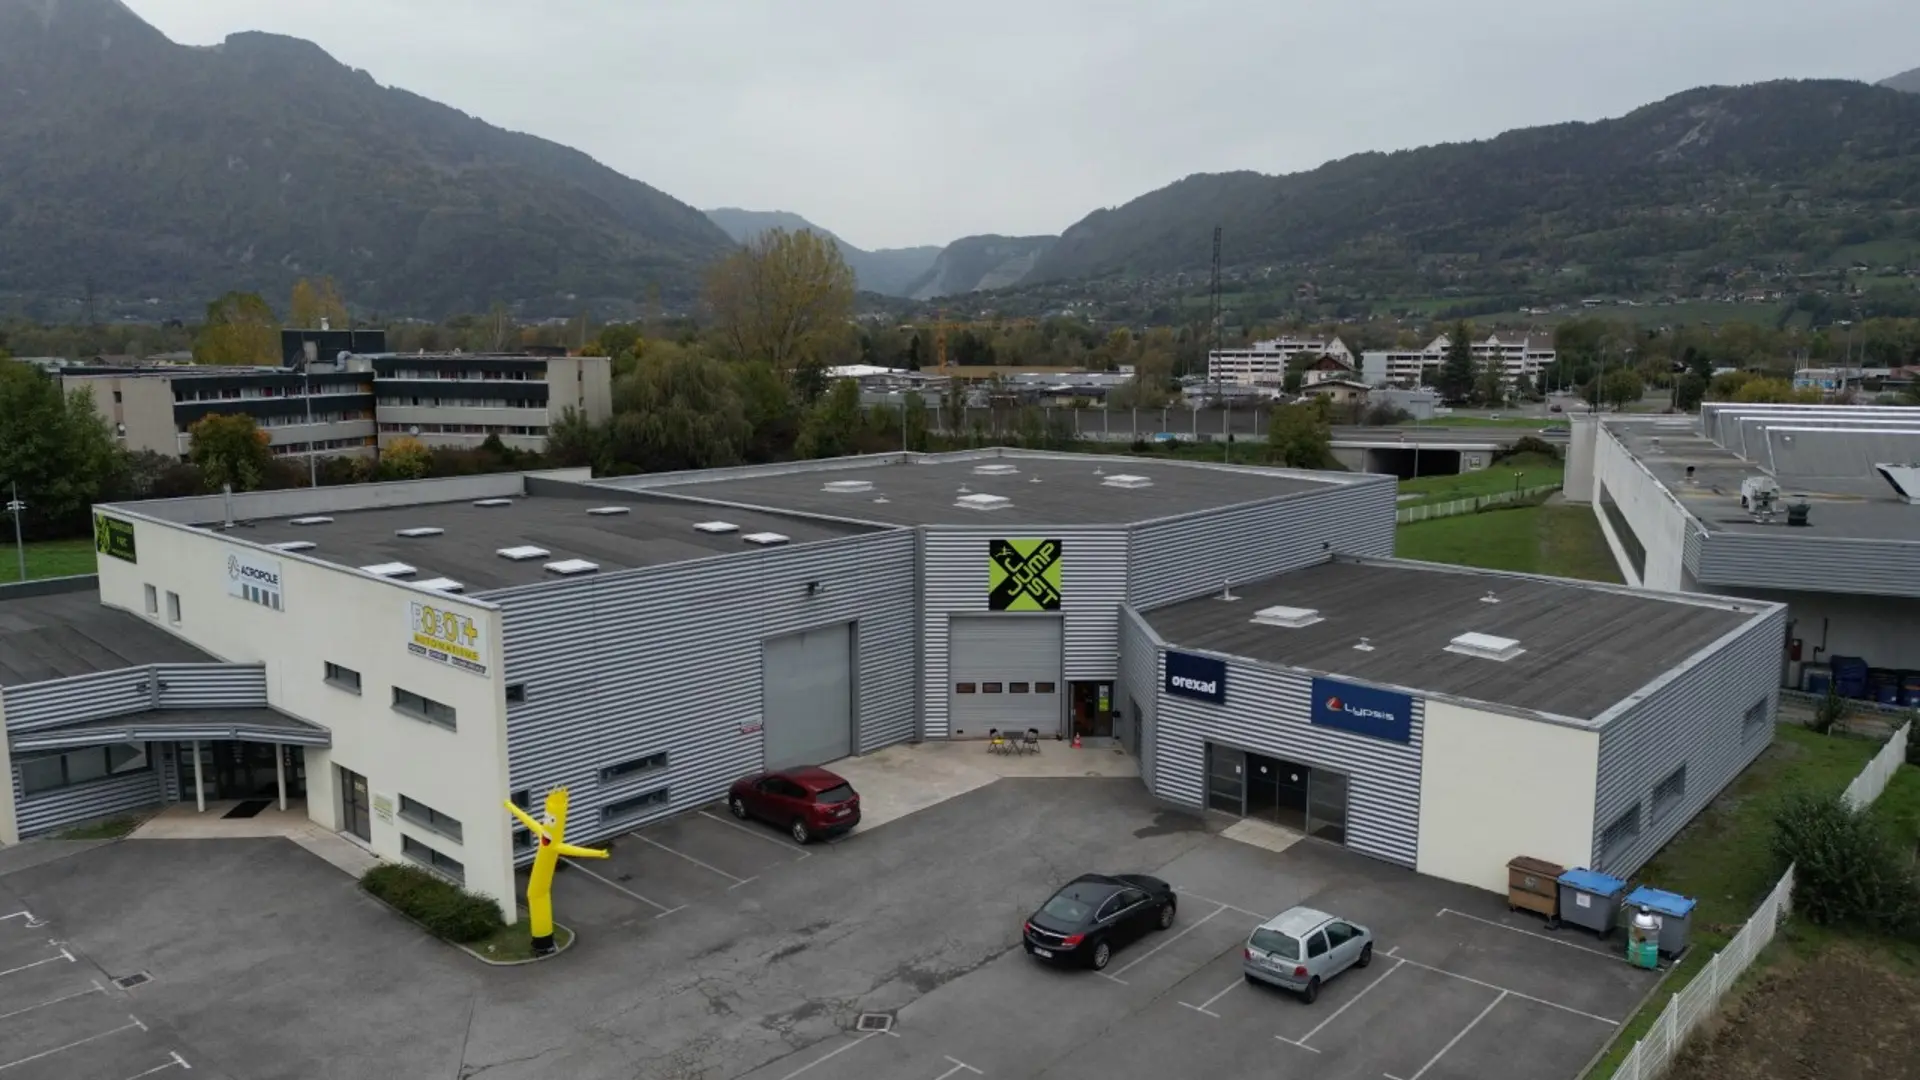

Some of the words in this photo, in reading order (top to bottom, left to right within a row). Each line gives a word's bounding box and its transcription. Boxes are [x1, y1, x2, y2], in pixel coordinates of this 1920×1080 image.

[241, 565, 279, 585] ACROPOLE
[1007, 543, 1055, 597] JUMP
[1172, 675, 1217, 694] orexad
